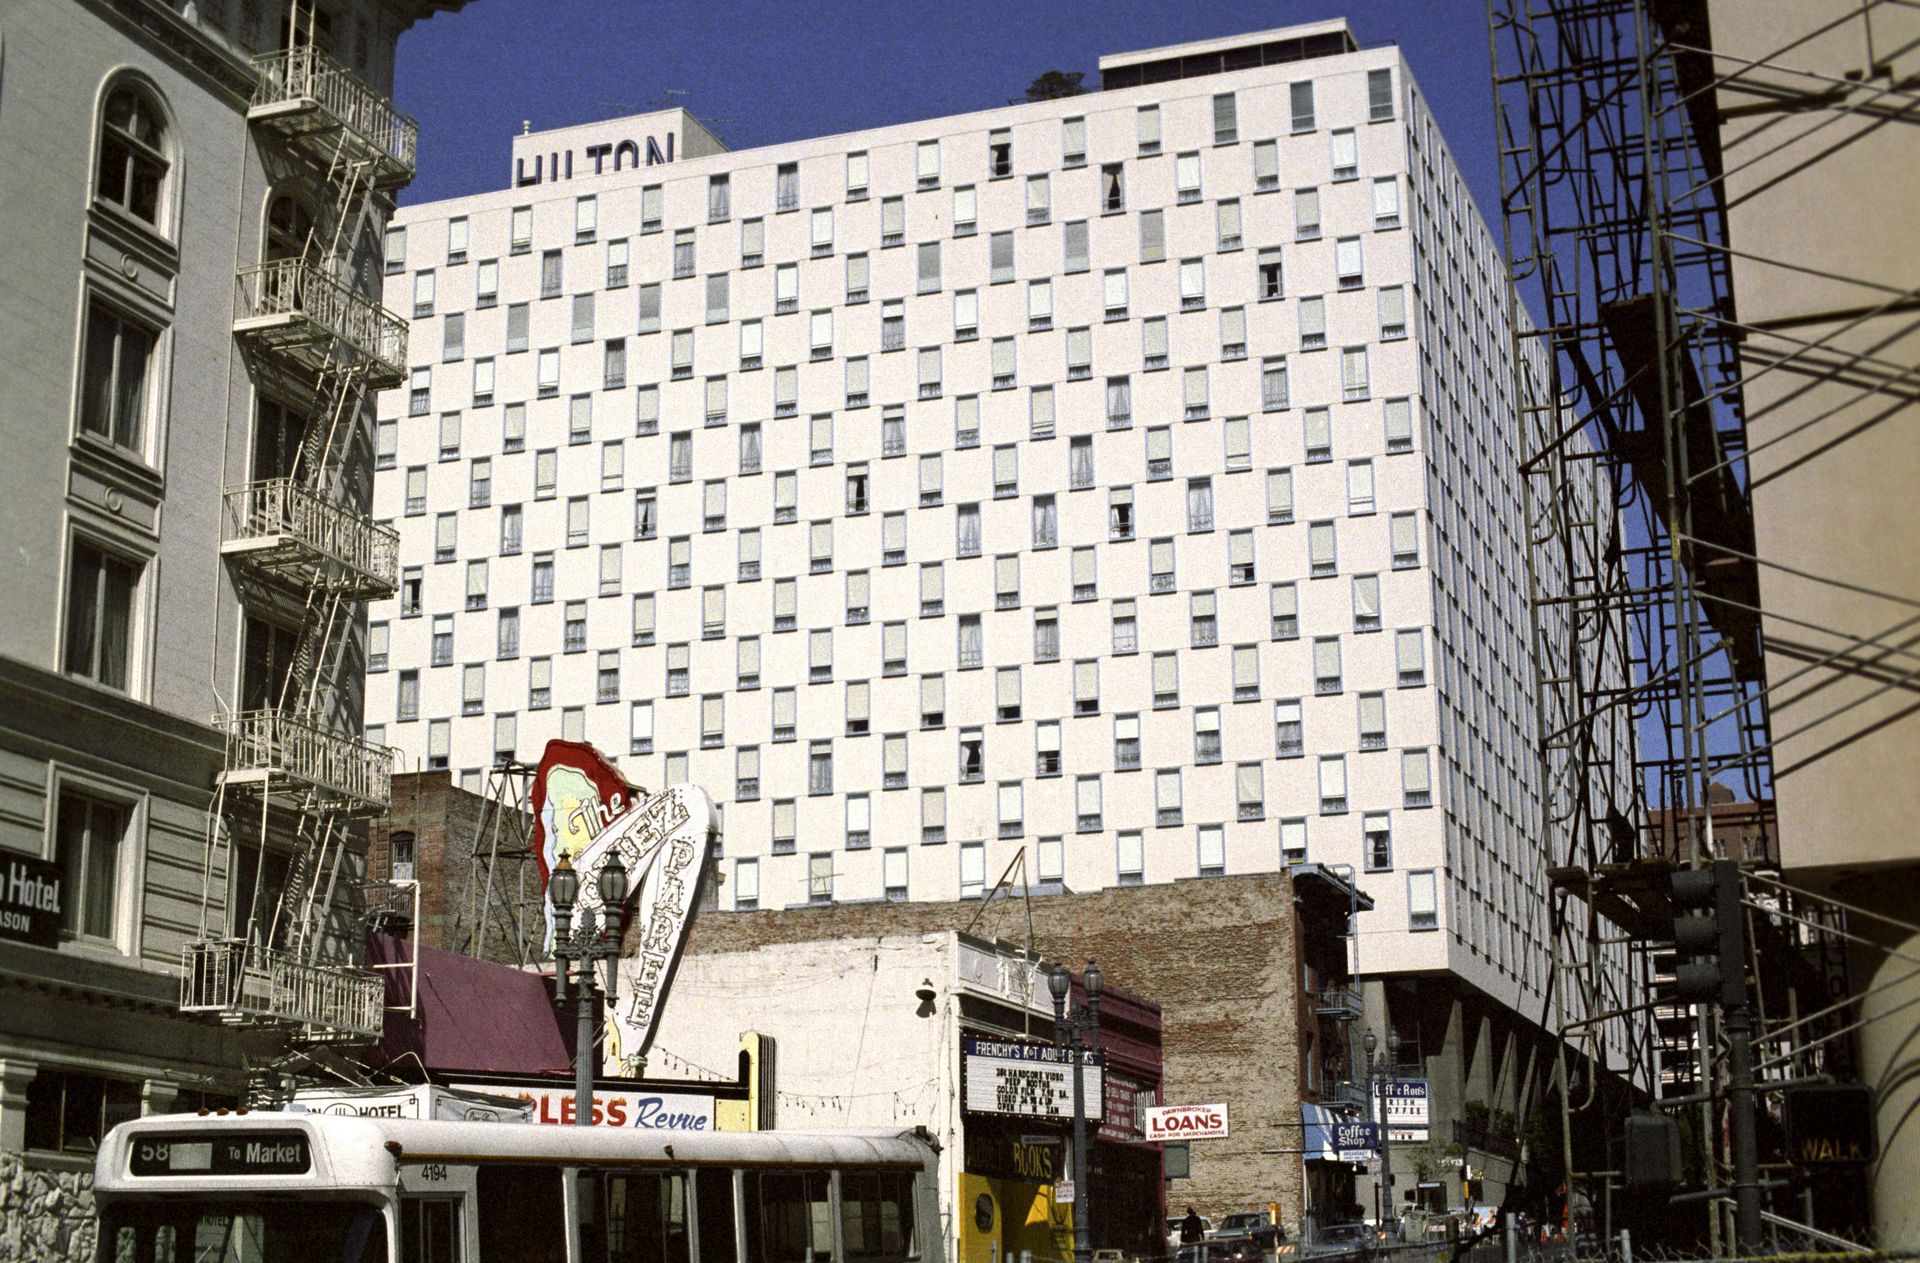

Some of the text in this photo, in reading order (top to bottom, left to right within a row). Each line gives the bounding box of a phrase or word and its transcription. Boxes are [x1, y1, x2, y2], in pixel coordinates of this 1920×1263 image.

[567, 790, 626, 840] The
[0, 910, 31, 933] SON
[625, 838, 696, 1030] PAREE
[975, 1041, 1020, 1059] FRENCHY'S
[1041, 1048, 1067, 1063] ADUT
[1068, 1050, 1094, 1065] BKS
[1045, 1072, 1064, 1082] VIDEO
[997, 1085, 1018, 1095] COLOR
[1375, 1083, 1402, 1097] Cffe
[358, 1103, 407, 1119] HOTEL
[634, 1097, 708, 1131] Revue
[1387, 1107, 1421, 1115] OFFEE
[1152, 1113, 1223, 1132] LOANS
[1338, 1125, 1371, 1138] Coffee
[1337, 1136, 1365, 1148] Shop
[1801, 1136, 1864, 1162] WALK
[140, 1142, 302, 1164] 58 To Market
[421, 1164, 448, 1182] 4194
